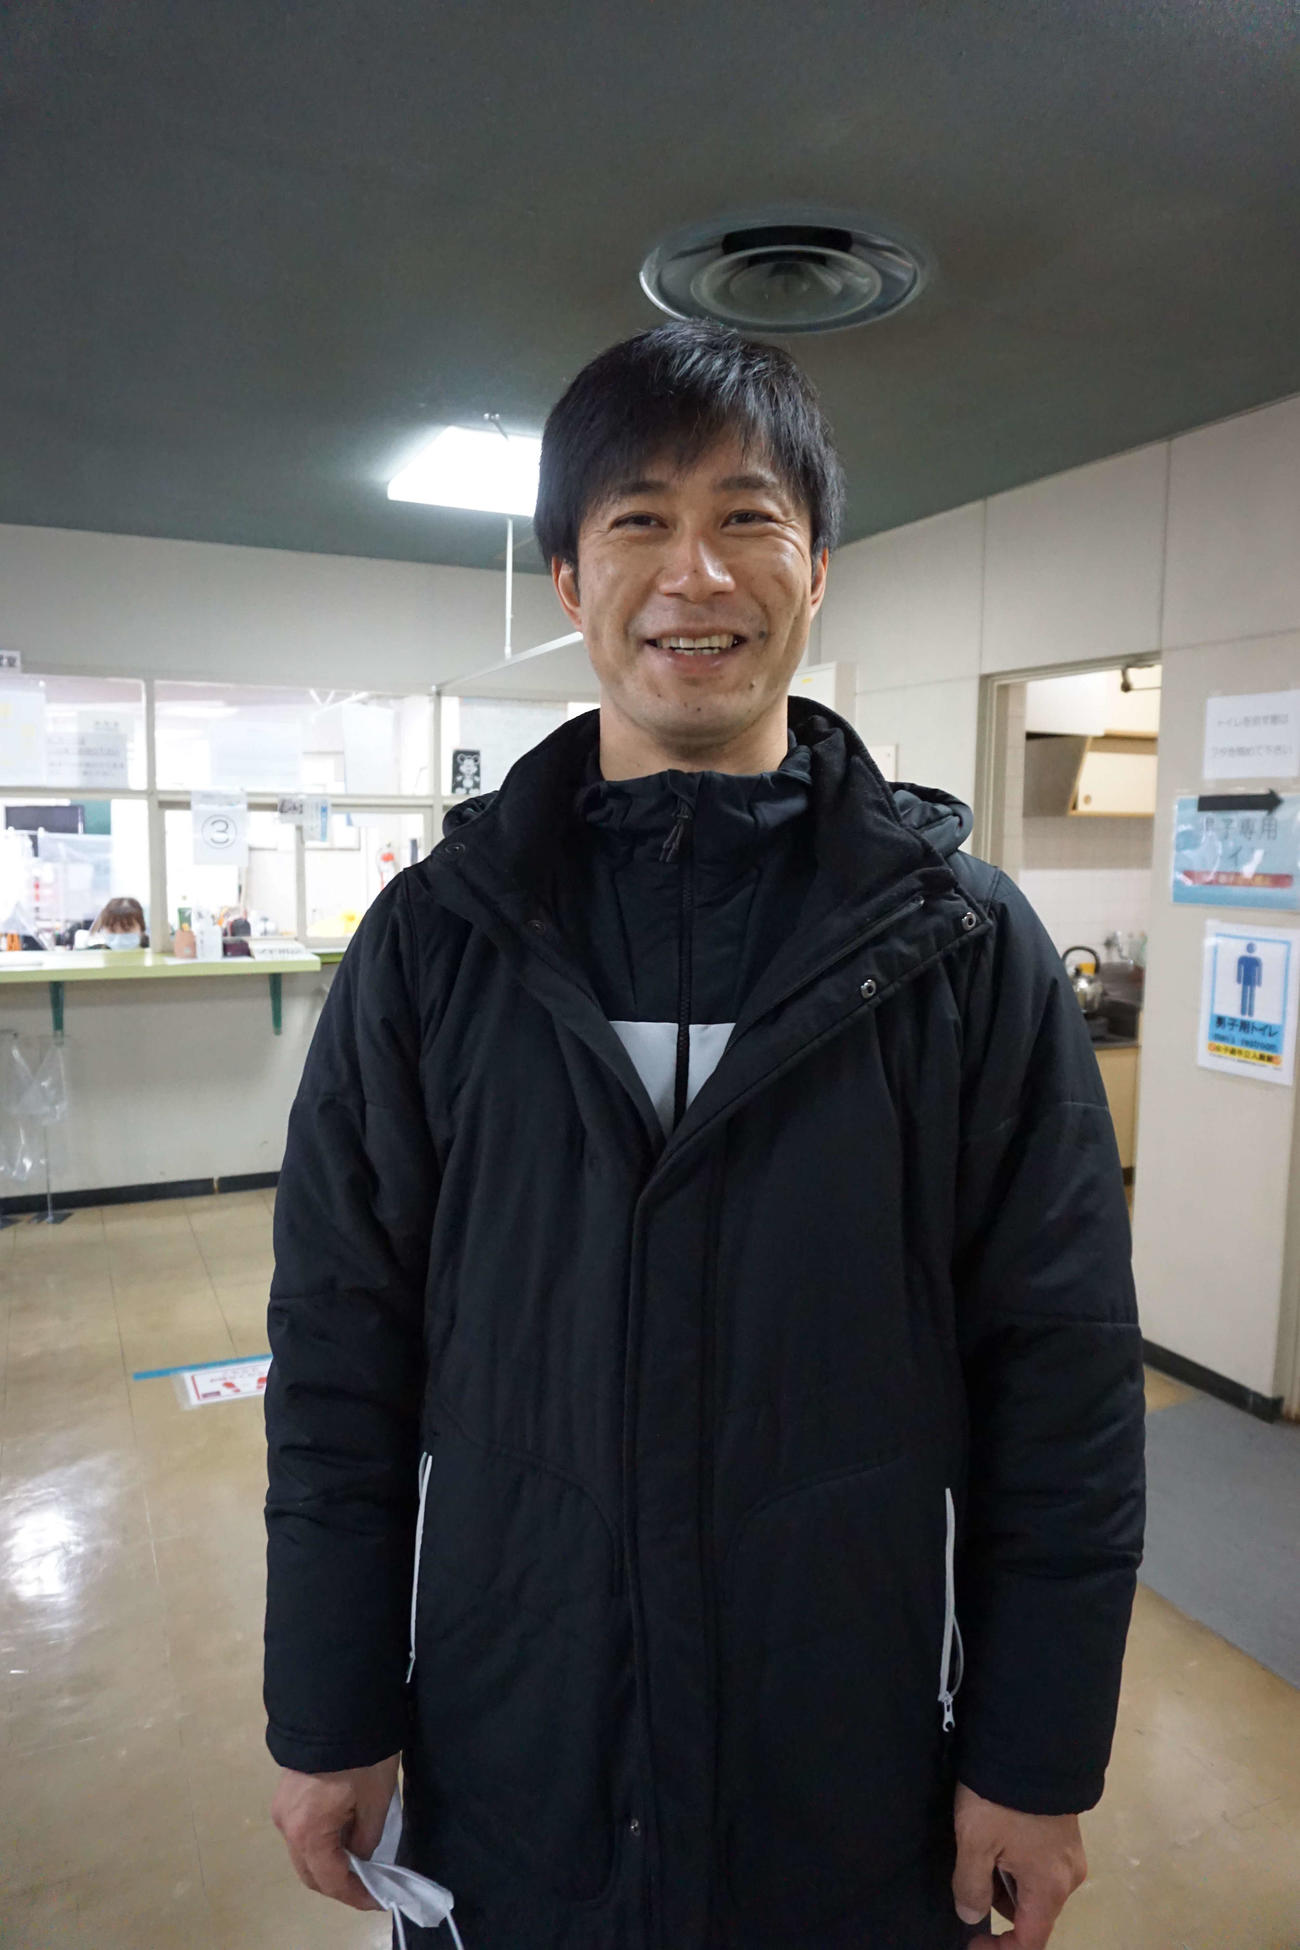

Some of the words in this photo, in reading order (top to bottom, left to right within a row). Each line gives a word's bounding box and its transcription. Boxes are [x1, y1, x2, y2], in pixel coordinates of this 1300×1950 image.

[1215, 1015, 1279, 1038] 男子用トイレ
